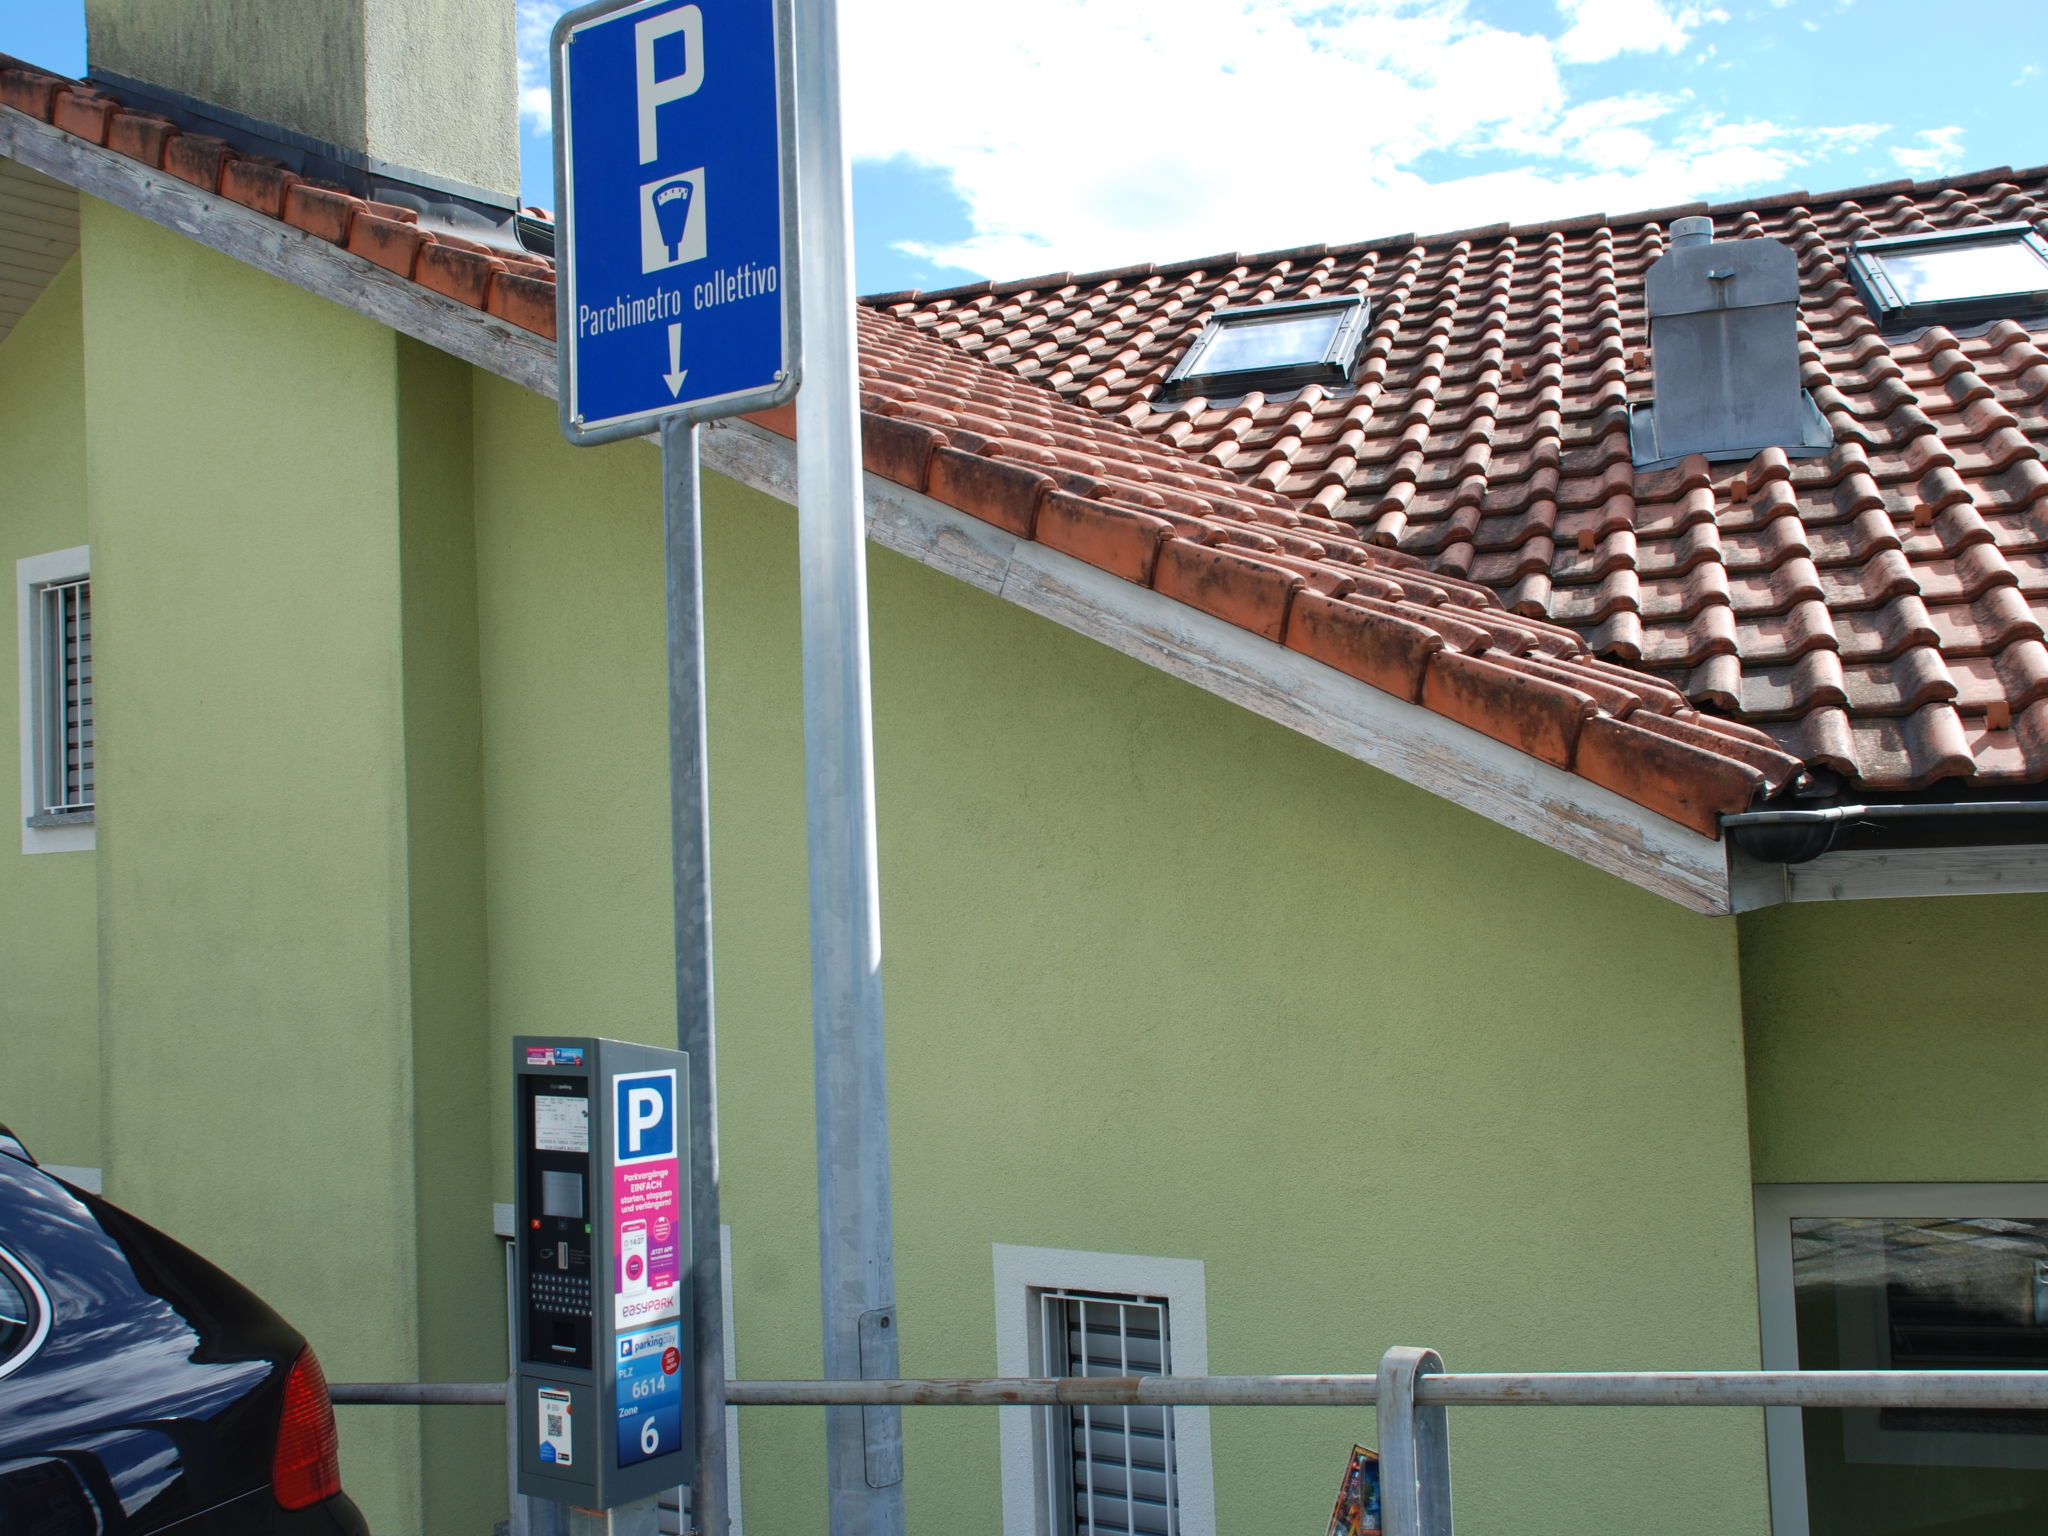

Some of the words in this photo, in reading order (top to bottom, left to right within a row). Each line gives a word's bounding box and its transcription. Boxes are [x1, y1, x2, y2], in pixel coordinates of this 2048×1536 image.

[635, 4, 705, 166] P
[579, 286, 681, 339] Parchimetro
[693, 262, 777, 311] collettivo
[629, 1087, 664, 1152] P
[623, 1169, 669, 1183] Parkvorgänge
[630, 1180, 663, 1193] EINFACH
[620, 1194, 645, 1205] starten,
[646, 1190, 672, 1201] stoppen
[621, 1204, 635, 1214] und
[635, 1198, 672, 1210] verlängern!
[635, 1335, 676, 1353] parkingpay
[618, 1367, 634, 1379] PLZ
[632, 1375, 666, 1398] 6614
[618, 1406, 639, 1418] Zone
[641, 1415, 659, 1454] 6
